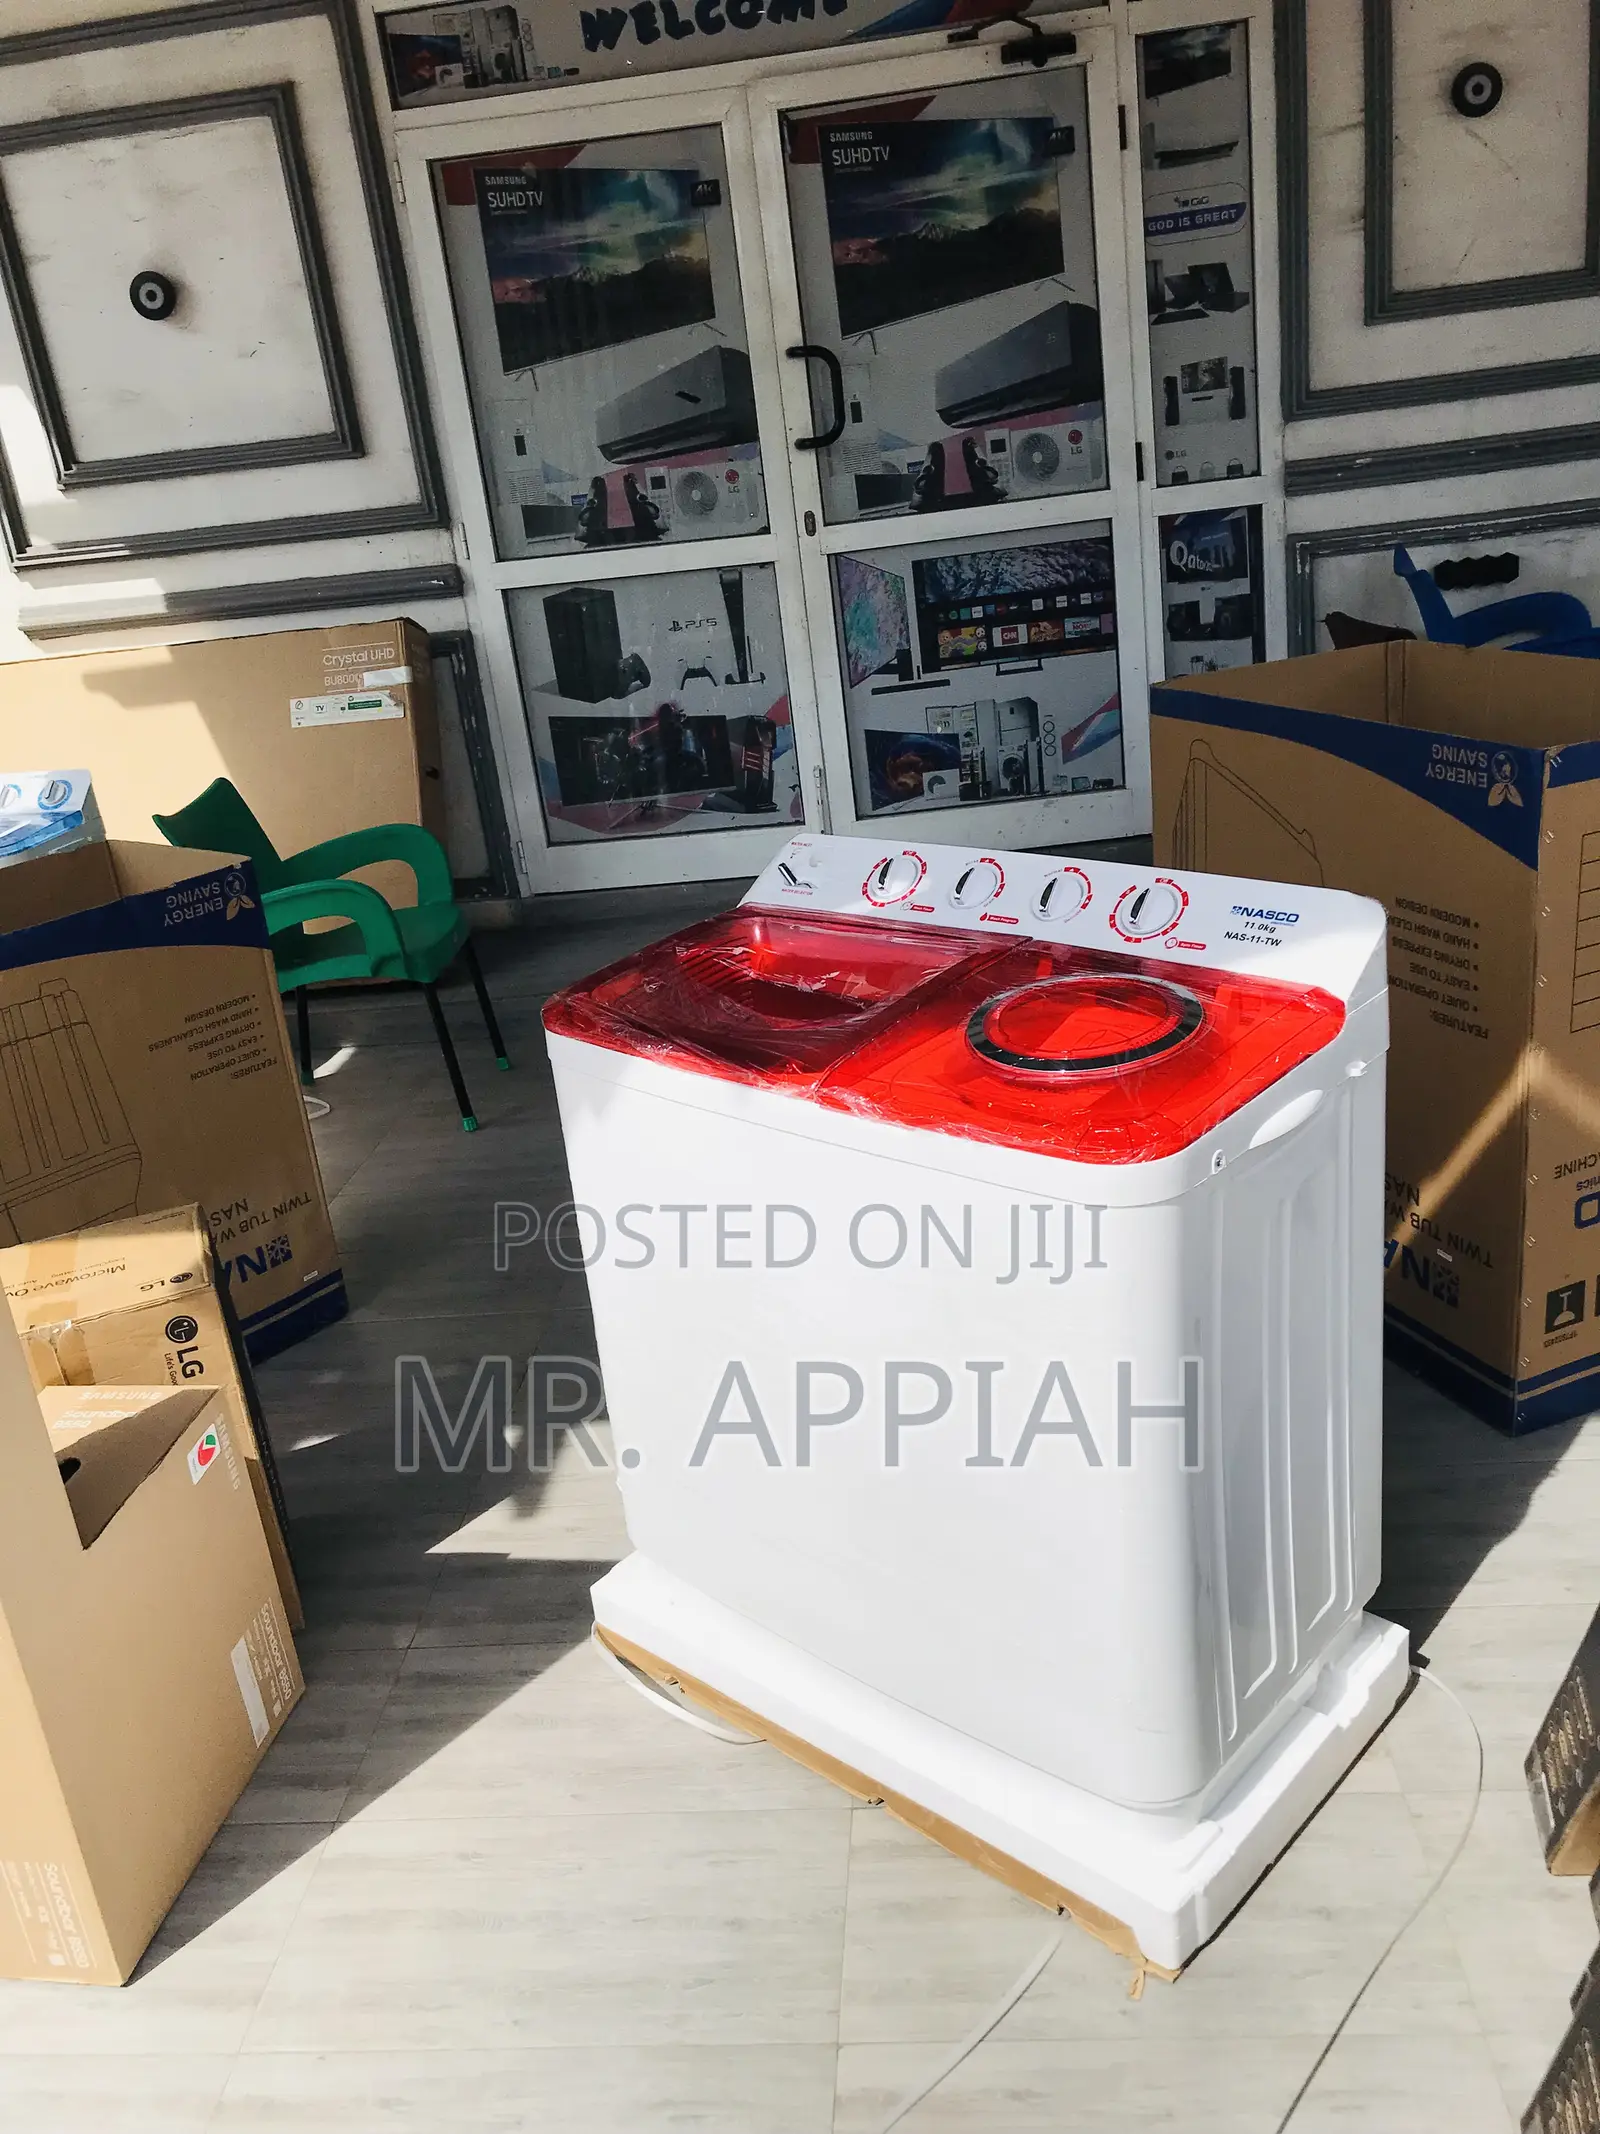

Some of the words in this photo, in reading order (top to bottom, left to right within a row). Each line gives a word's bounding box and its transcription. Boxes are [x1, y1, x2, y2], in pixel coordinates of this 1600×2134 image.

[830, 131, 873, 142] SAMSUNG
[485, 176, 527, 185] SAMSUNG
[1148, 219, 1174, 231] GOD
[1179, 217, 1190, 227] IS
[1195, 209, 1237, 224] GREAT
[1071, 446, 1083, 455] LG
[685, 617, 717, 629] PS5
[1003, 631, 1018, 640] CNN
[323, 650, 368, 667] Crystal
[371, 648, 395, 660] UHD
[1432, 744, 1488, 769] SAVING
[1425, 763, 1488, 788] ENERGY
[166, 882, 220, 909] SAVING
[164, 899, 224, 927] ENERGY
[1241, 907, 1300, 923] NASCO
[1430, 907, 1471, 928] MODERN
[1244, 921, 1277, 934] 11.0kg
[1414, 924, 1440, 940] WASH
[1224, 931, 1282, 947] NAS-11-TW
[1392, 936, 1431, 957] EXPRESS
[1442, 932, 1470, 950] HAND
[1433, 950, 1471, 970] DRYING
[1410, 962, 1428, 977] USE
[1429, 969, 1441, 982] TO
[1442, 974, 1471, 991] EASY
[216, 995, 250, 1013] MODERN
[1440, 994, 1470, 1012] QUIET
[184, 1007, 215, 1023] DESIGN
[205, 1017, 229, 1031] WASH
[230, 1008, 252, 1022] HAND
[1429, 1009, 1489, 1039] FEATURES:
[148, 1026, 204, 1052] CLEANLINESS
[225, 1022, 255, 1038] DRYING
[188, 1033, 223, 1052] EXPRESS
[224, 1043, 236, 1053] TO
[237, 1035, 258, 1048] EASY
[207, 1048, 224, 1060] USE
[237, 1048, 261, 1063] QUIET
[190, 1058, 236, 1081] OPERATION
[230, 1056, 278, 1080] FEATURES:
[272, 1192, 312, 1219] TWIN
[239, 1211, 270, 1234] TUB
[1410, 1212, 1442, 1241] TUB
[1447, 1232, 1494, 1269] TWIN
[33, 1264, 126, 1292] Microwave
[140, 1281, 166, 1293] LG
[177, 1345, 204, 1379] LG
[78, 1391, 163, 1401] SAMSUNG
[216, 1413, 241, 1491] SAMSUNG
[259, 1601, 284, 1668] Soundbar
[277, 1665, 293, 1701] B550
[44, 1862, 76, 1937] Soundbar
